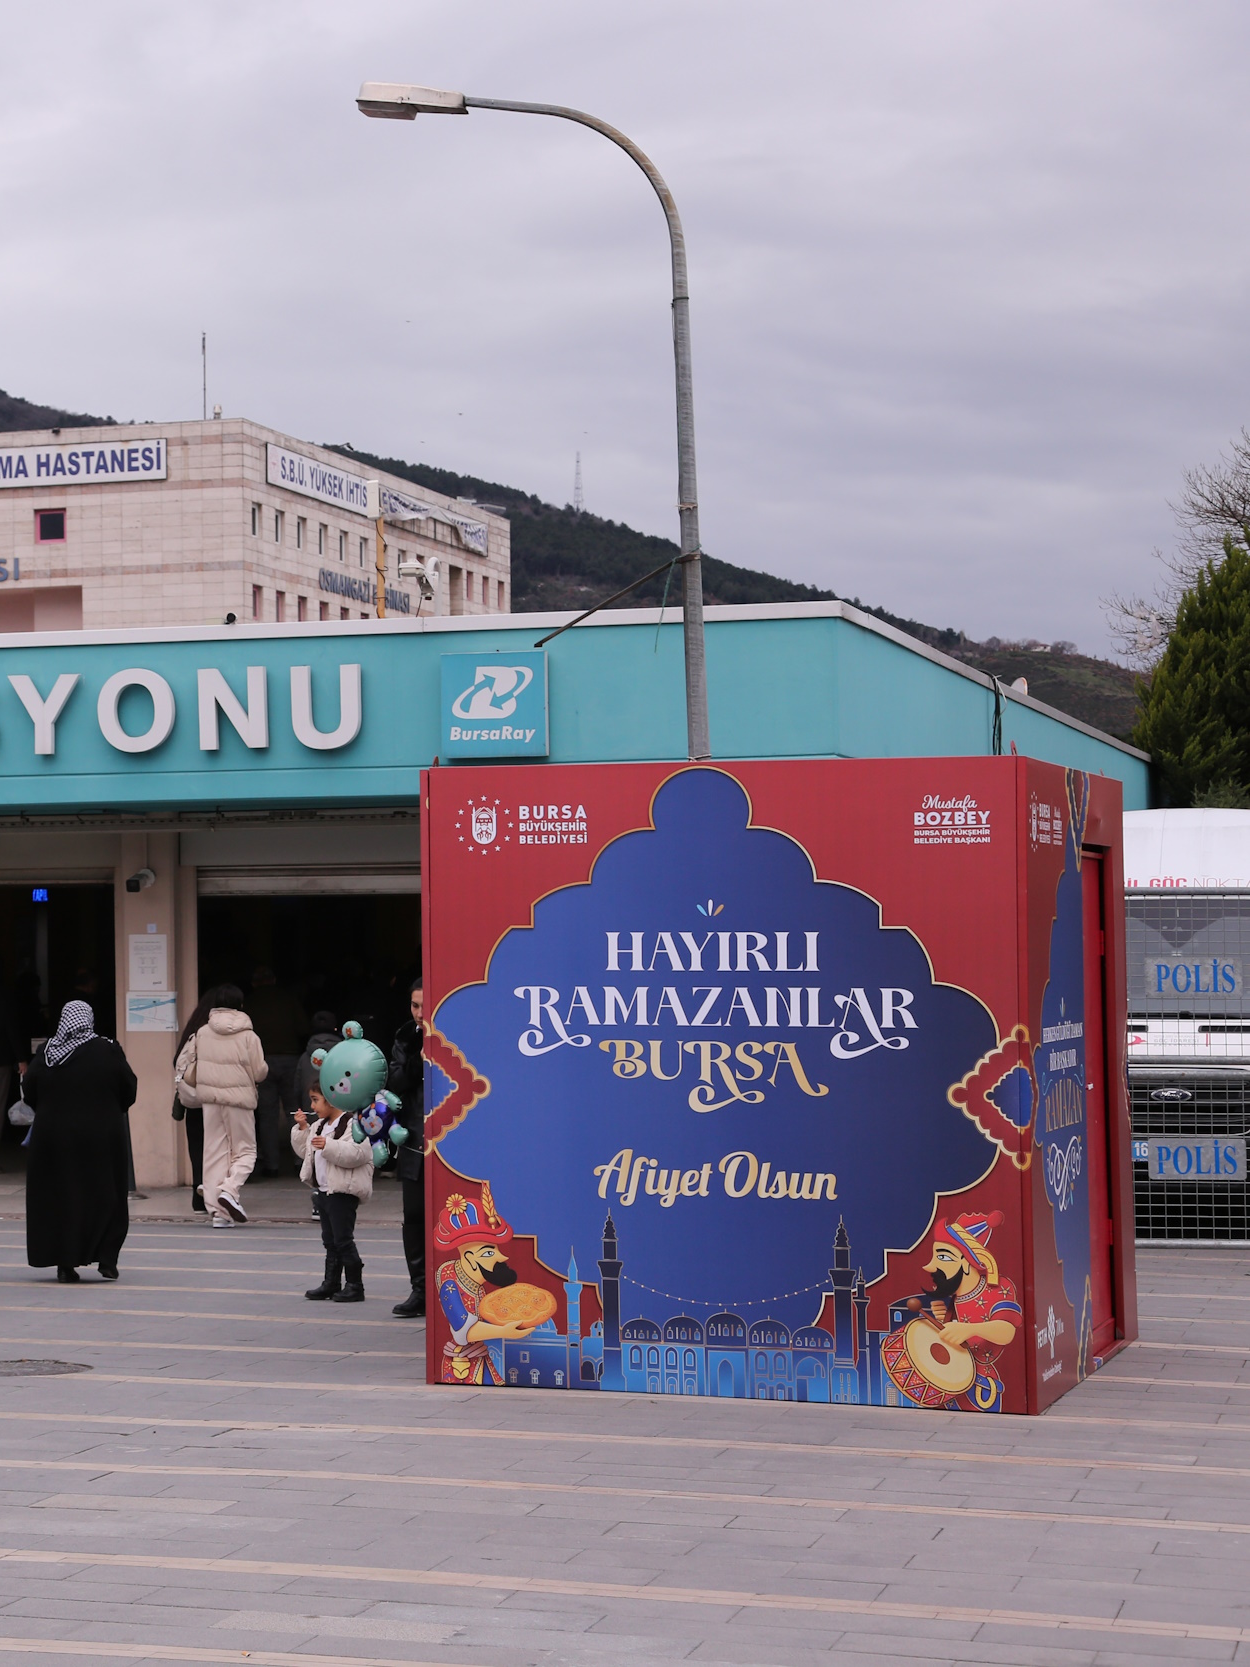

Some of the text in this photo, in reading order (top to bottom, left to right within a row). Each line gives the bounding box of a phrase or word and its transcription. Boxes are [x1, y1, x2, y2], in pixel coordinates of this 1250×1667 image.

[36, 441, 162, 477] HASTANESİ
[309, 464, 344, 499] YÜKSEK
[319, 568, 370, 603] OSMANGAZİ
[450, 725, 536, 743] BursaRay
[519, 805, 587, 820] BURSA
[914, 811, 990, 826] BOZBEY
[922, 794, 978, 812] Mustafa
[519, 820, 587, 833] BÜYÜKŞEHİR
[519, 832, 588, 844] BELEDİYESİ
[914, 836, 991, 845] BELEDİYE BAŞKANI
[942, 827, 990, 837] BÜYÜKŞEHİR
[605, 931, 820, 972] HAYIRLI
[1155, 959, 1236, 993] POLİS
[513, 985, 920, 1060] RAMAZANLAR
[598, 1039, 830, 1113] BURSA
[1045, 1078, 1083, 1133] RAMAZAN
[1156, 1139, 1238, 1175] POLİS
[593, 1148, 838, 1208] Afiyet Olsun
